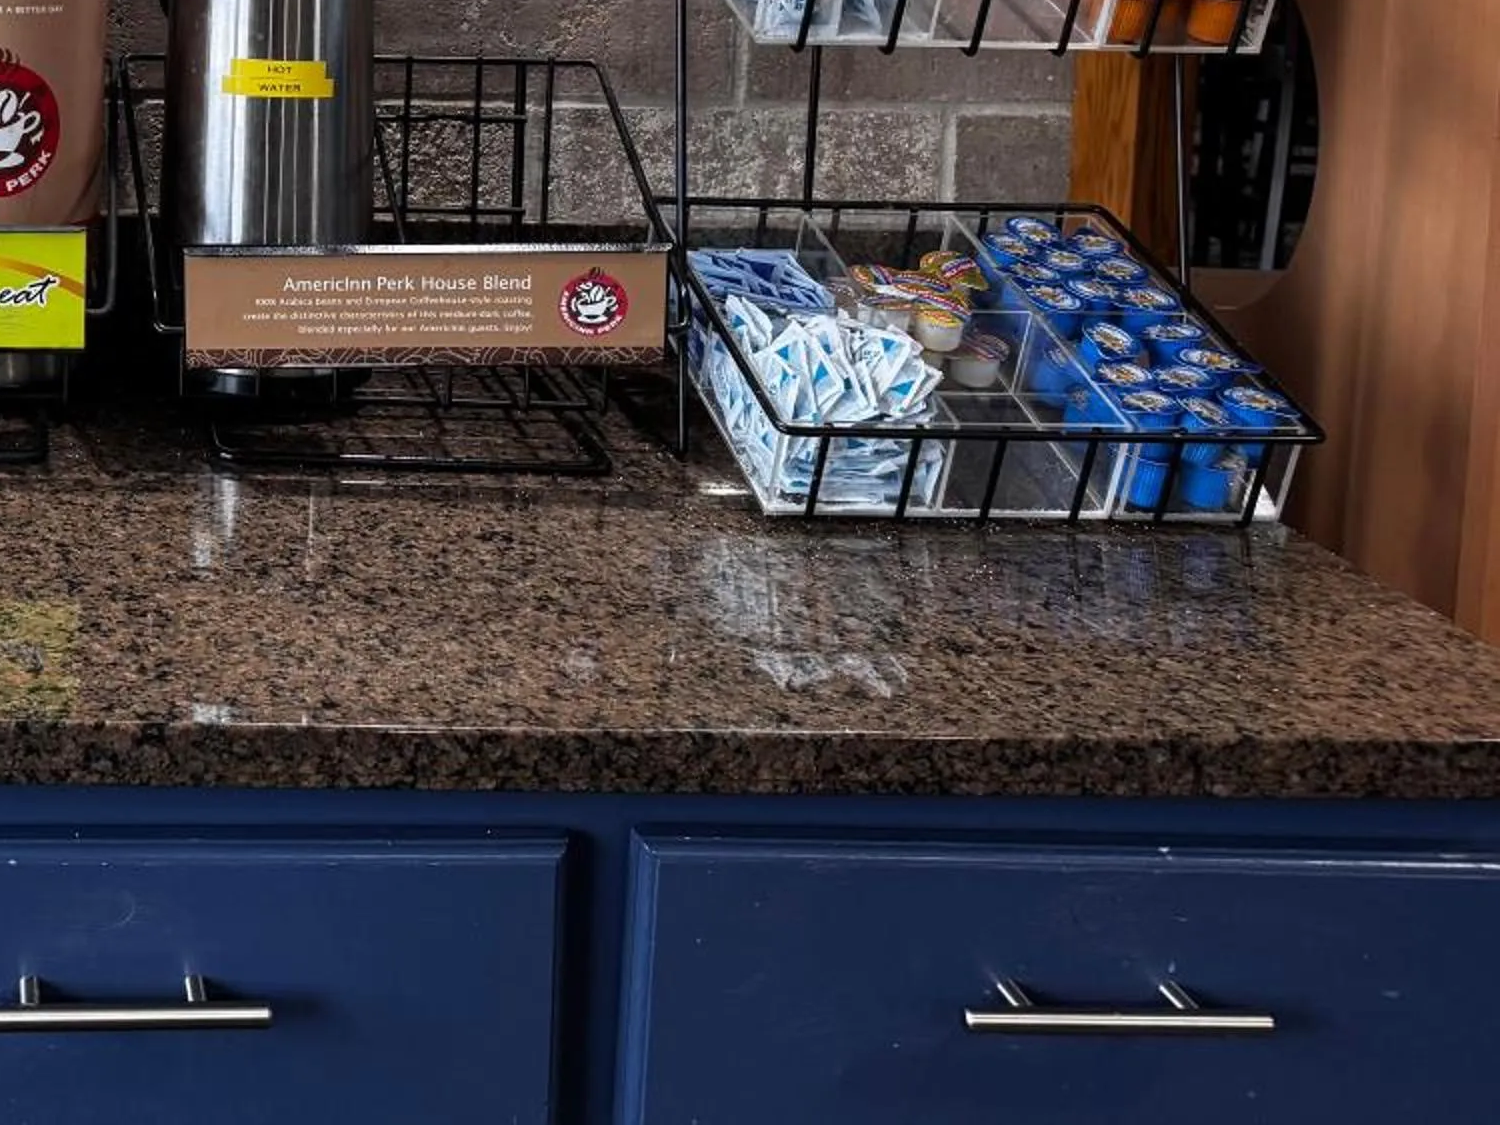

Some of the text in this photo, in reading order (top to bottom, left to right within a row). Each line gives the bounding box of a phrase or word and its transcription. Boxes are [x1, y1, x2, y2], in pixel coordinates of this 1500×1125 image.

[267, 65, 292, 74] HOT
[259, 83, 301, 92] WATER
[5, 149, 51, 192] PERK
[376, 276, 415, 291] Perk
[421, 275, 477, 291] House
[483, 275, 532, 290] Blend
